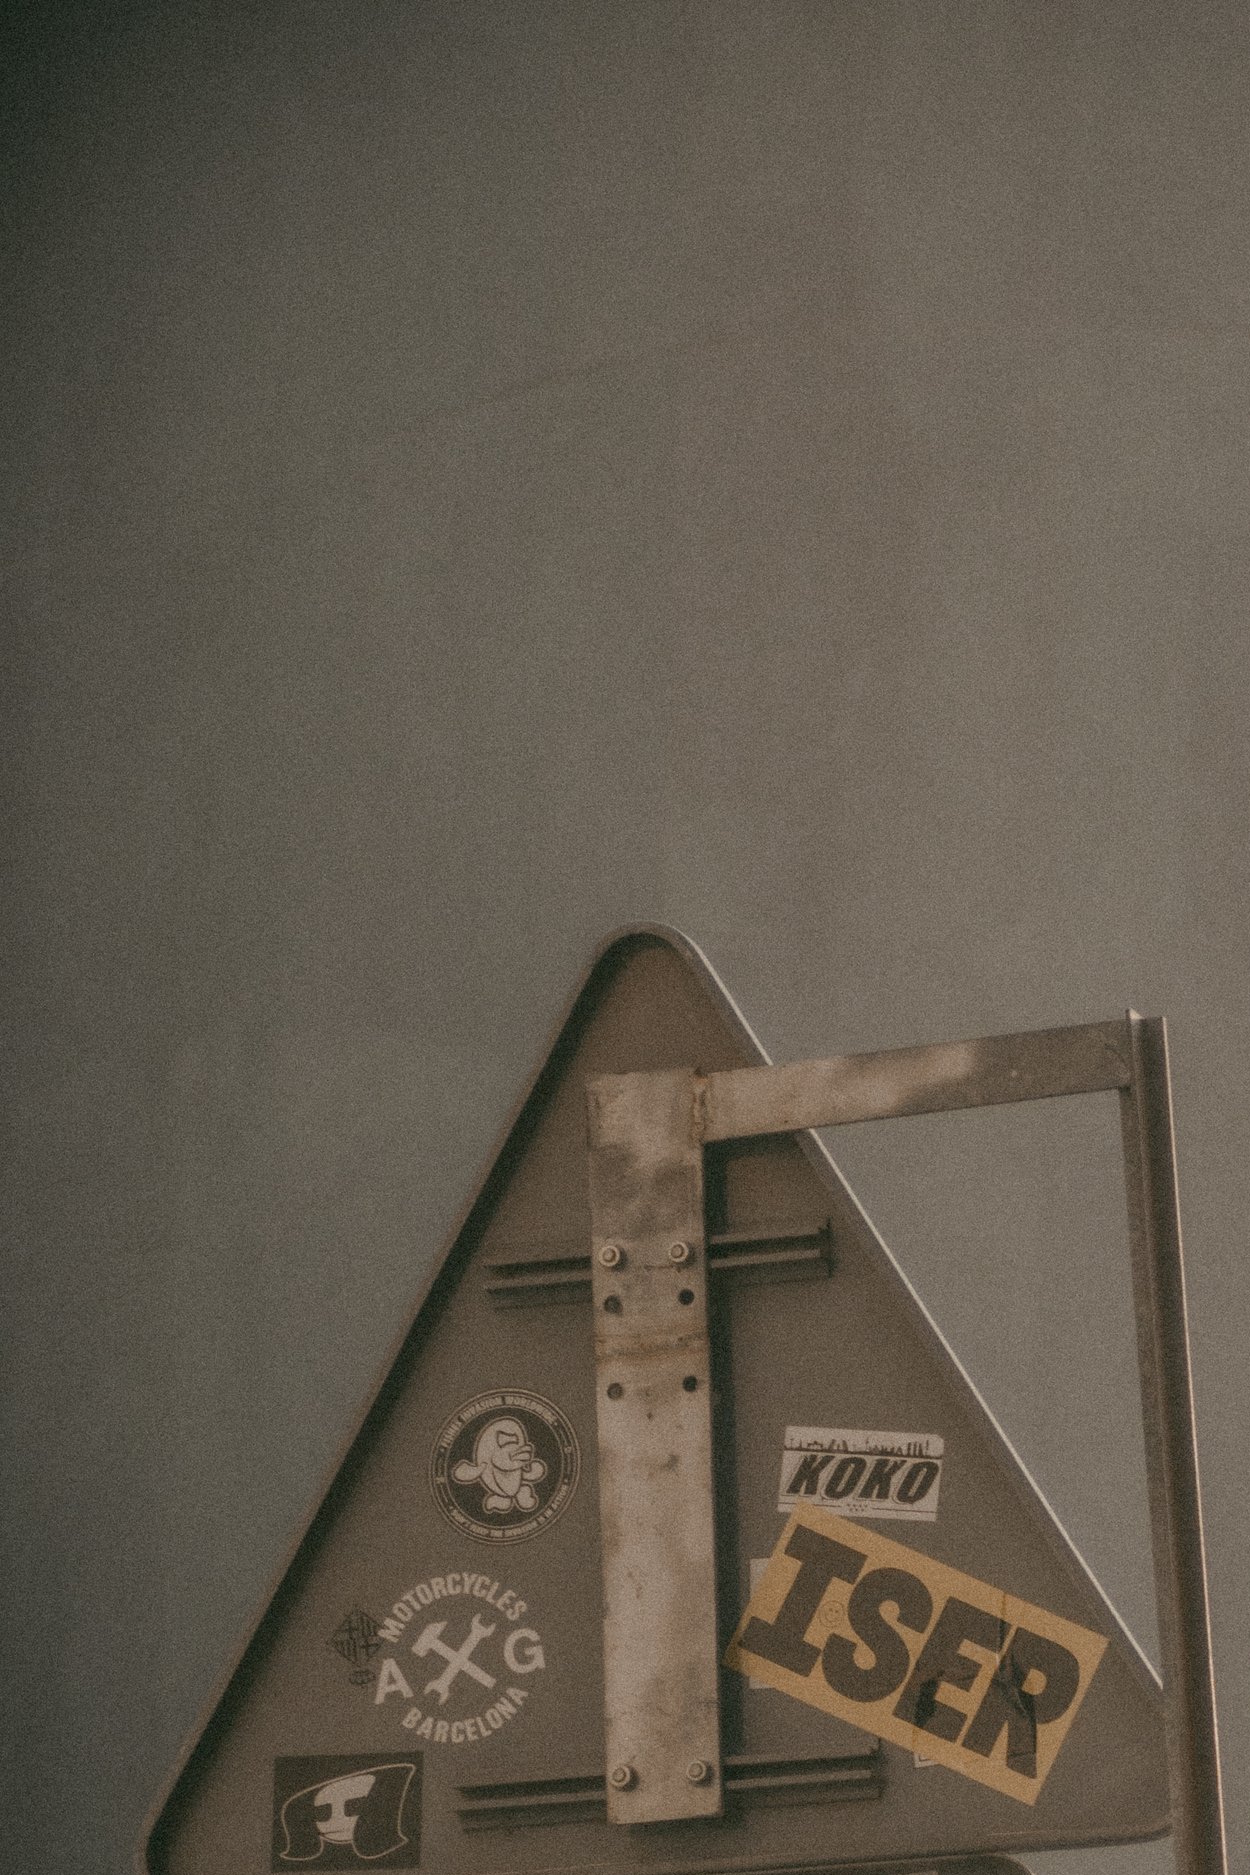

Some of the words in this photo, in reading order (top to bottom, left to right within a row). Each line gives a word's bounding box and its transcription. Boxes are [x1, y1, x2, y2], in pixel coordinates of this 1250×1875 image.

[786, 1455, 940, 1504] KOKO
[377, 1572, 528, 1643] MOTORCYCLES
[374, 1658, 414, 1705] A
[503, 1627, 546, 1674] G
[740, 1525, 1080, 1779] ISER
[401, 1686, 529, 1743] BARCELONA
